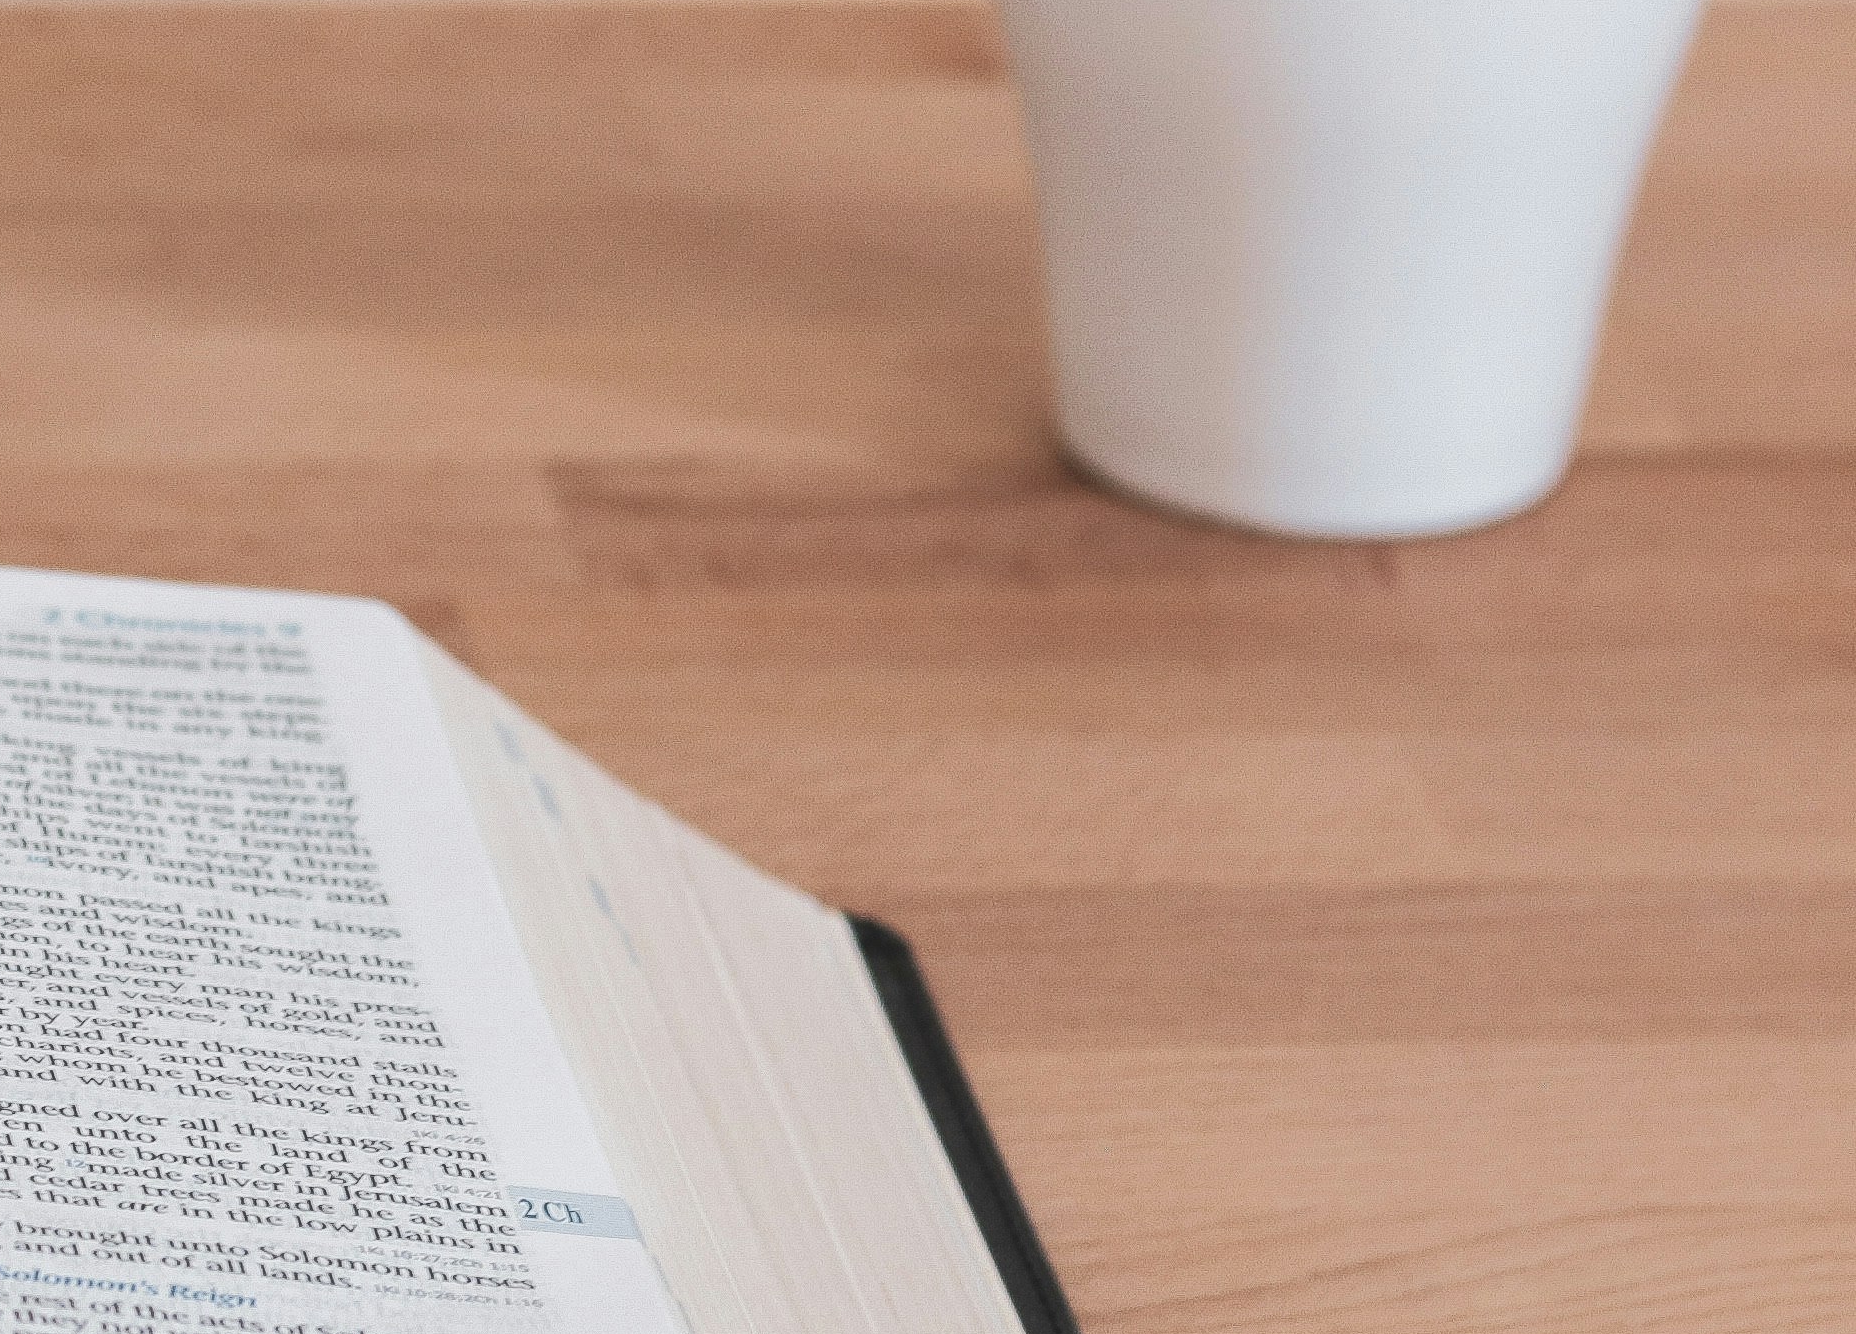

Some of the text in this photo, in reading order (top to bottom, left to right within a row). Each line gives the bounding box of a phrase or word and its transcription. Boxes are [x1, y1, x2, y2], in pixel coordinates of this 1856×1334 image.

[40, 1019, 105, 1041] had
[116, 1031, 188, 1049] four
[200, 1040, 361, 1068] thousand
[373, 1060, 457, 1078] stalls
[77, 1075, 157, 1093] with
[175, 1083, 232, 1101] the
[249, 1090, 330, 1115] king
[346, 1103, 379, 1117] at
[396, 1106, 476, 1127] Jeru-
[24, 1136, 59, 1152] to
[69, 1141, 124, 1159] the
[134, 1146, 249, 1171] border
[259, 1161, 292, 1176] of
[305, 1164, 412, 1188] Egypt.
[93, 1110, 168, 1127] over
[180, 1118, 220, 1133] all
[233, 1122, 288, 1141] the
[301, 1128, 394, 1154] kings
[404, 1140, 488, 1163] from
[518, 1198, 583, 1224] 2 Ch
[168, 1283, 256, 1309] Reign
